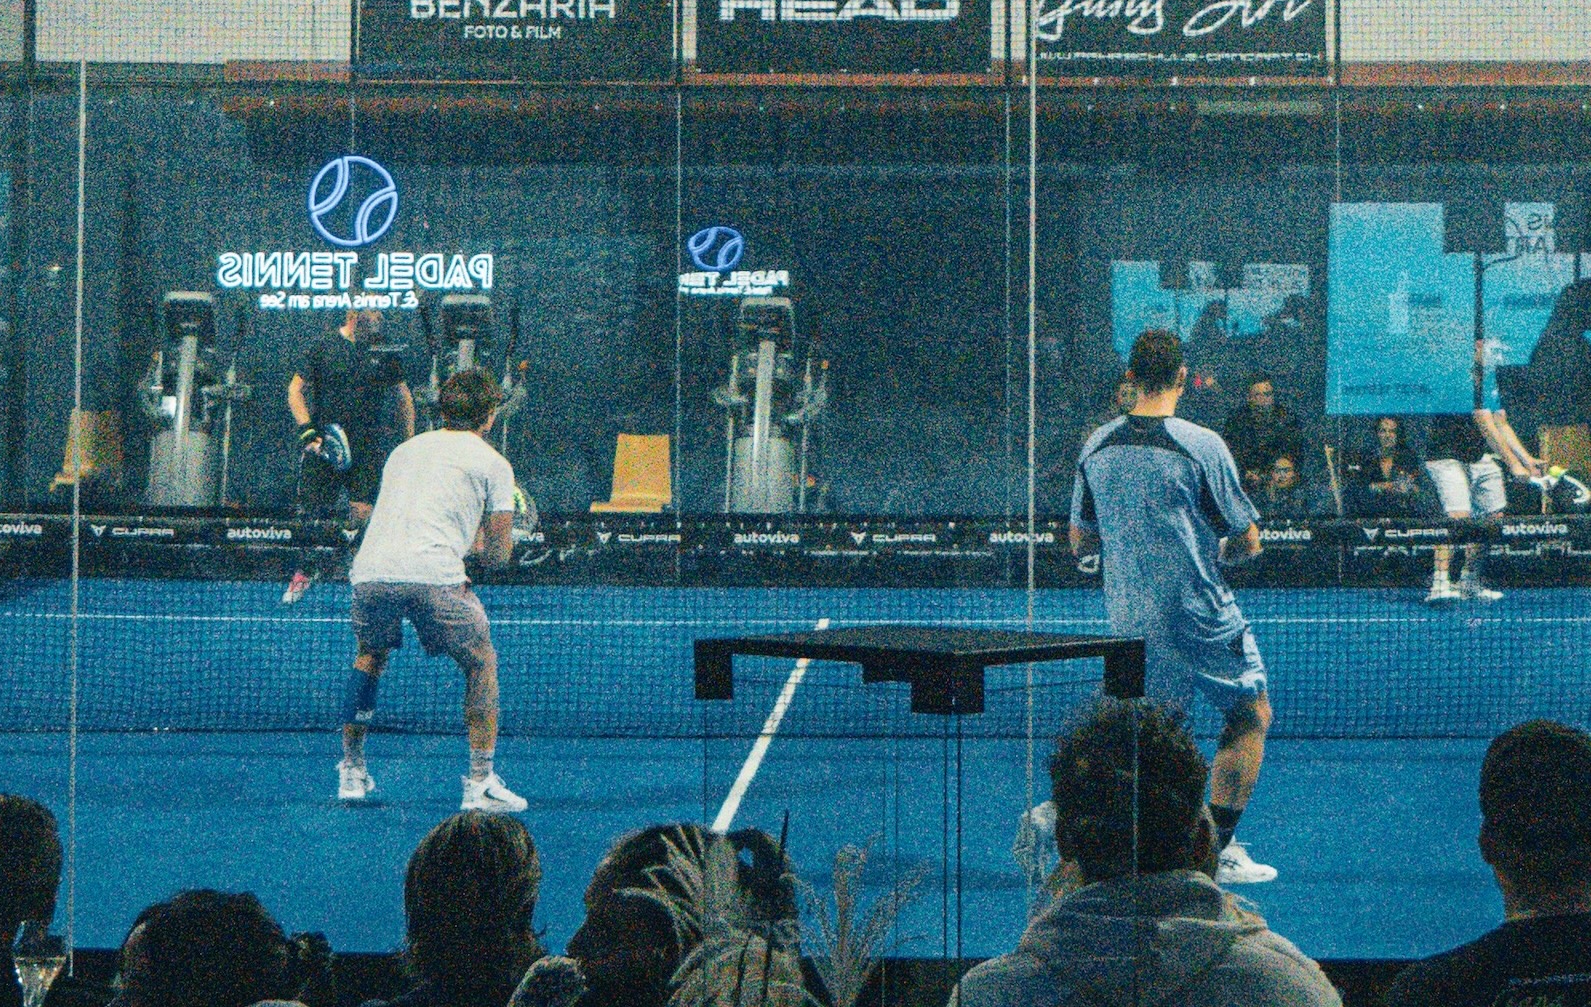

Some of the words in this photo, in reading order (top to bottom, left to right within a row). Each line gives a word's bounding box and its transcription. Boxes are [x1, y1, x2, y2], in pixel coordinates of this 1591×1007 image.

[464, 25, 508, 39] FOTO
[510, 25, 523, 39] &
[525, 25, 562, 39] FILM
[112, 527, 175, 536] CUPRA
[226, 525, 292, 540] autoviva
[617, 533, 682, 543] CUPRA
[733, 529, 799, 544] autoviva
[872, 533, 937, 543] CUPRA
[989, 530, 1055, 544] autovva
[1257, 526, 1312, 541] utoviva
[1384, 528, 1450, 538] CUPRA
[1501, 520, 1568, 535] autoviva
